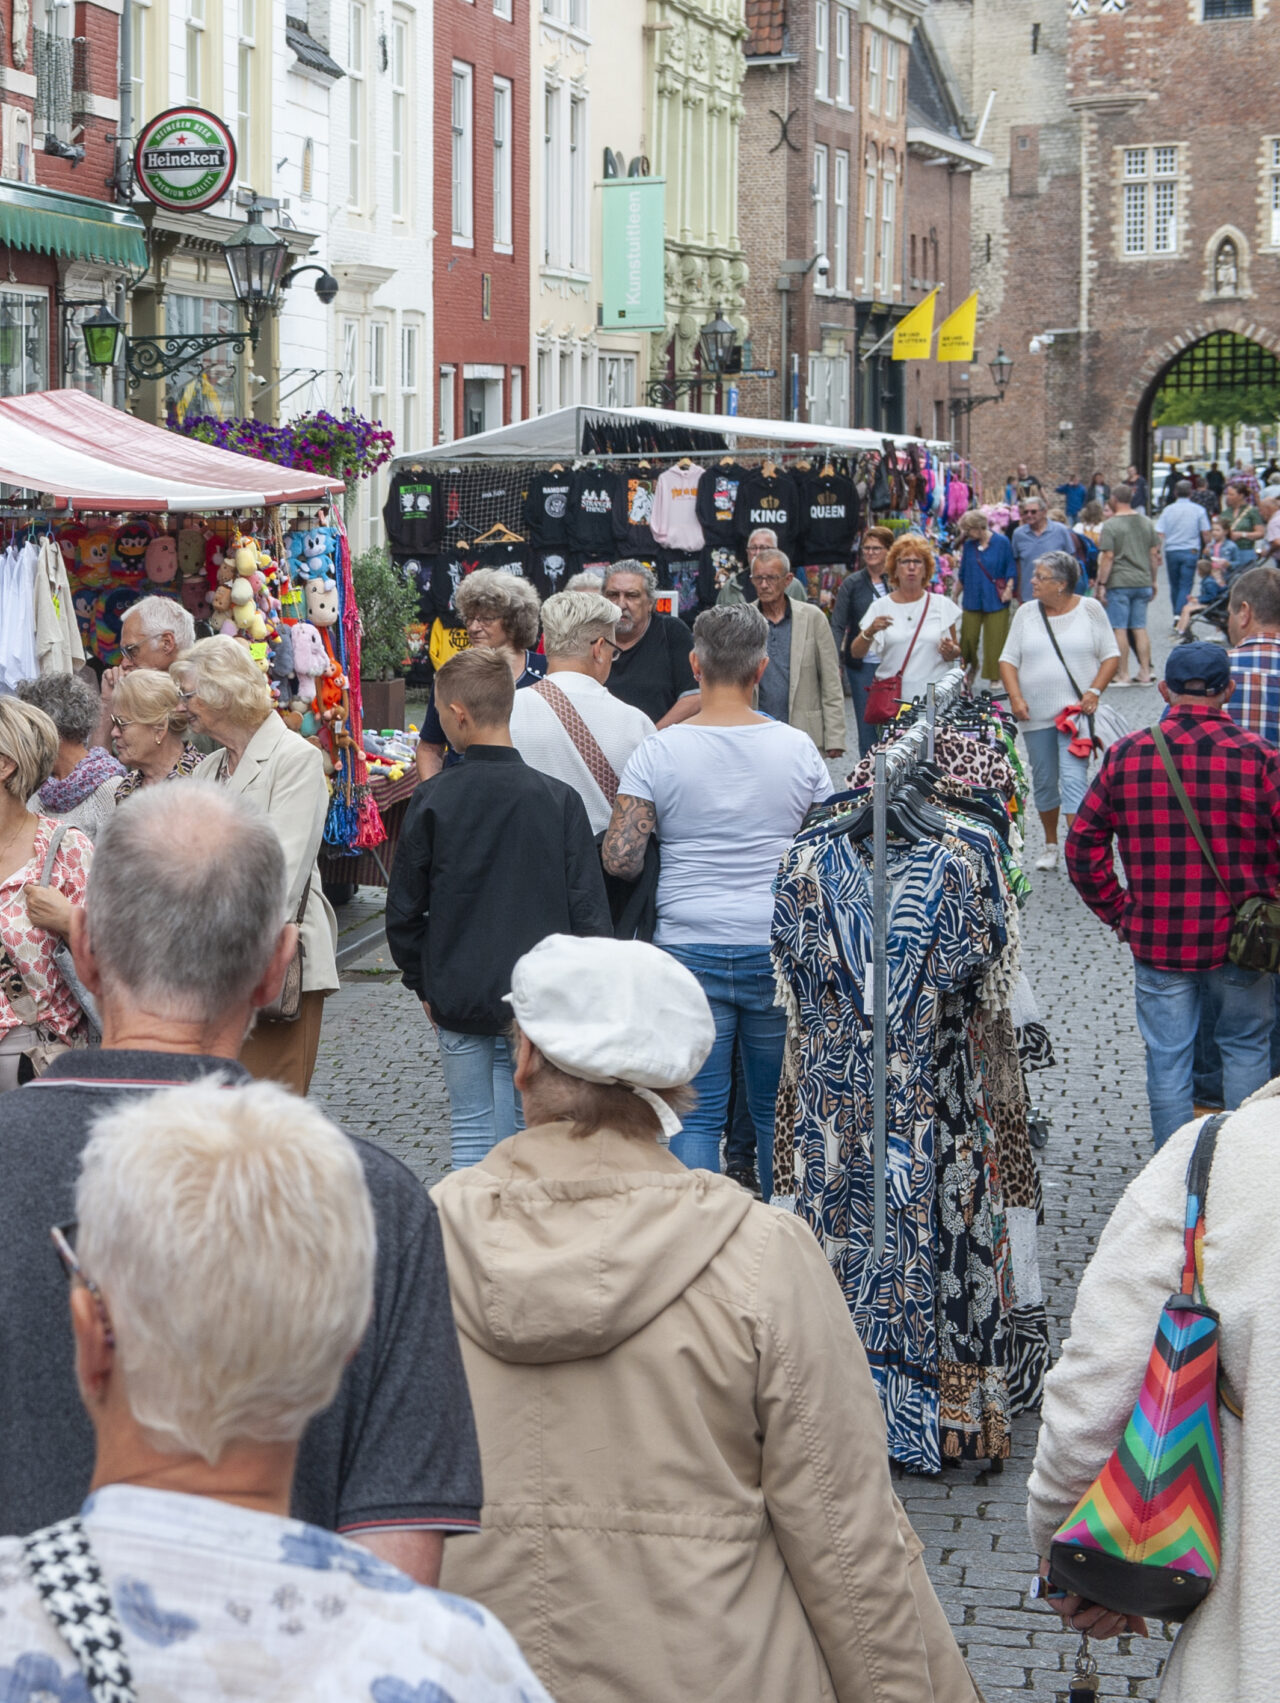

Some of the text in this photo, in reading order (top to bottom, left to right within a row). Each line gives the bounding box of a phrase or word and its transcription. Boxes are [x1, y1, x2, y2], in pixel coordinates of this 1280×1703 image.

[155, 121, 212, 140] HEINEKEN BEER
[147, 151, 220, 168] Heineken
[154, 176, 214, 197] PREMIUM QUALITY
[626, 191, 641, 305] Kunstuitleen
[750, 509, 787, 523] KING
[810, 505, 845, 518] QUEEN
